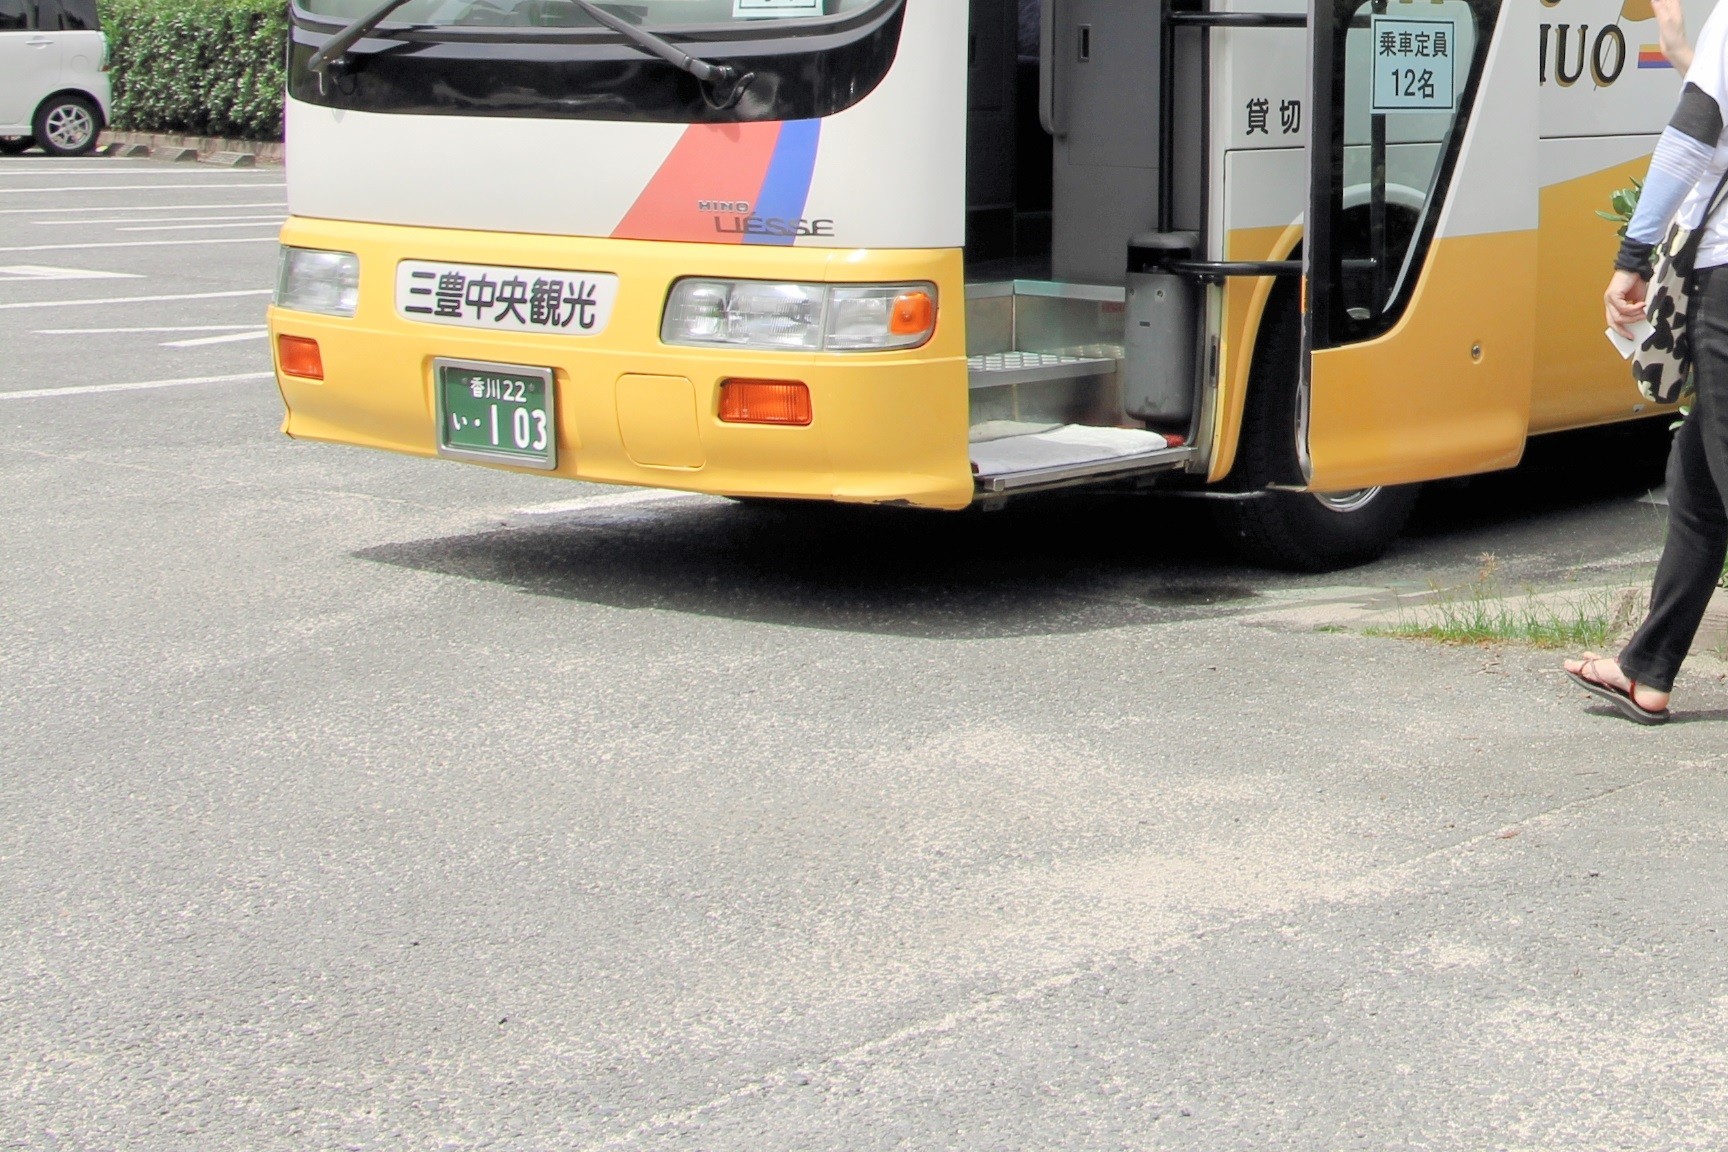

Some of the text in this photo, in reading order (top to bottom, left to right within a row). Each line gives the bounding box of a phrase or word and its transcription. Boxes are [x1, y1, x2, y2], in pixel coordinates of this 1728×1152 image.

[1378, 30, 1449, 59] 乗車定員
[1391, 67, 1436, 100] 12名
[697, 199, 749, 214] HINO
[403, 269, 597, 329] 三豊中央観光
